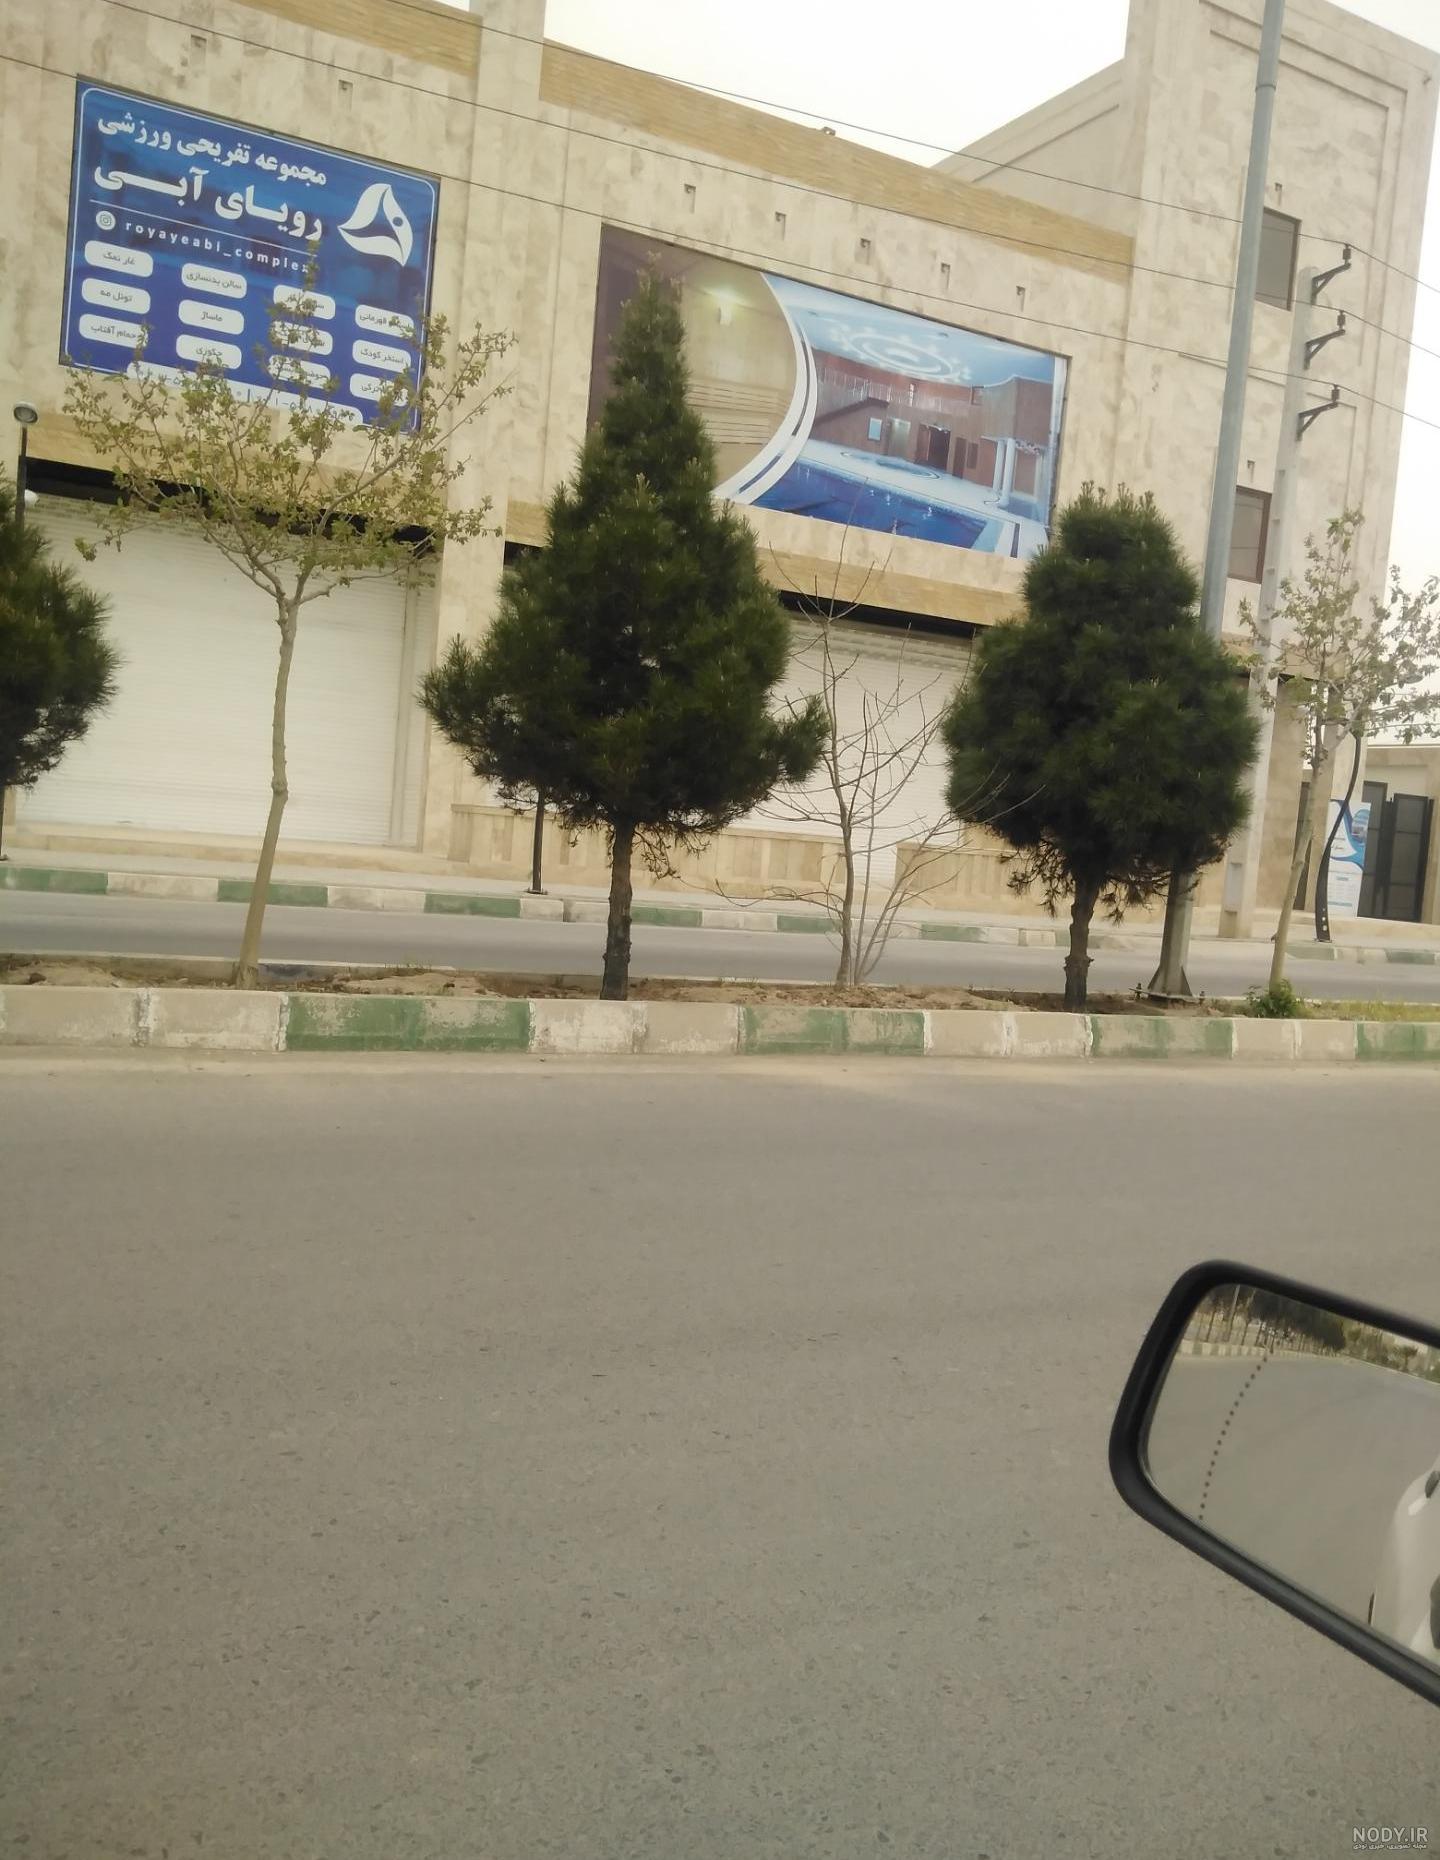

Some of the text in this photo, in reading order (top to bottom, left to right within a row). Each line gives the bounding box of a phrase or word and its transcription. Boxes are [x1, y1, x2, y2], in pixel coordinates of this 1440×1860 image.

[97, 112, 327, 187] مجموعه تفریحی ورزشی
[94, 165, 323, 241] رویای آبی
[125, 221, 309, 273] royayeabi_complex
[103, 251, 136, 266] غار نمک
[186, 272, 242, 289] سالن بدنسازی
[201, 311, 223, 322] ماساژ
[90, 325, 115, 335] آفتاب
[360, 348, 405, 364] استخر کودک
